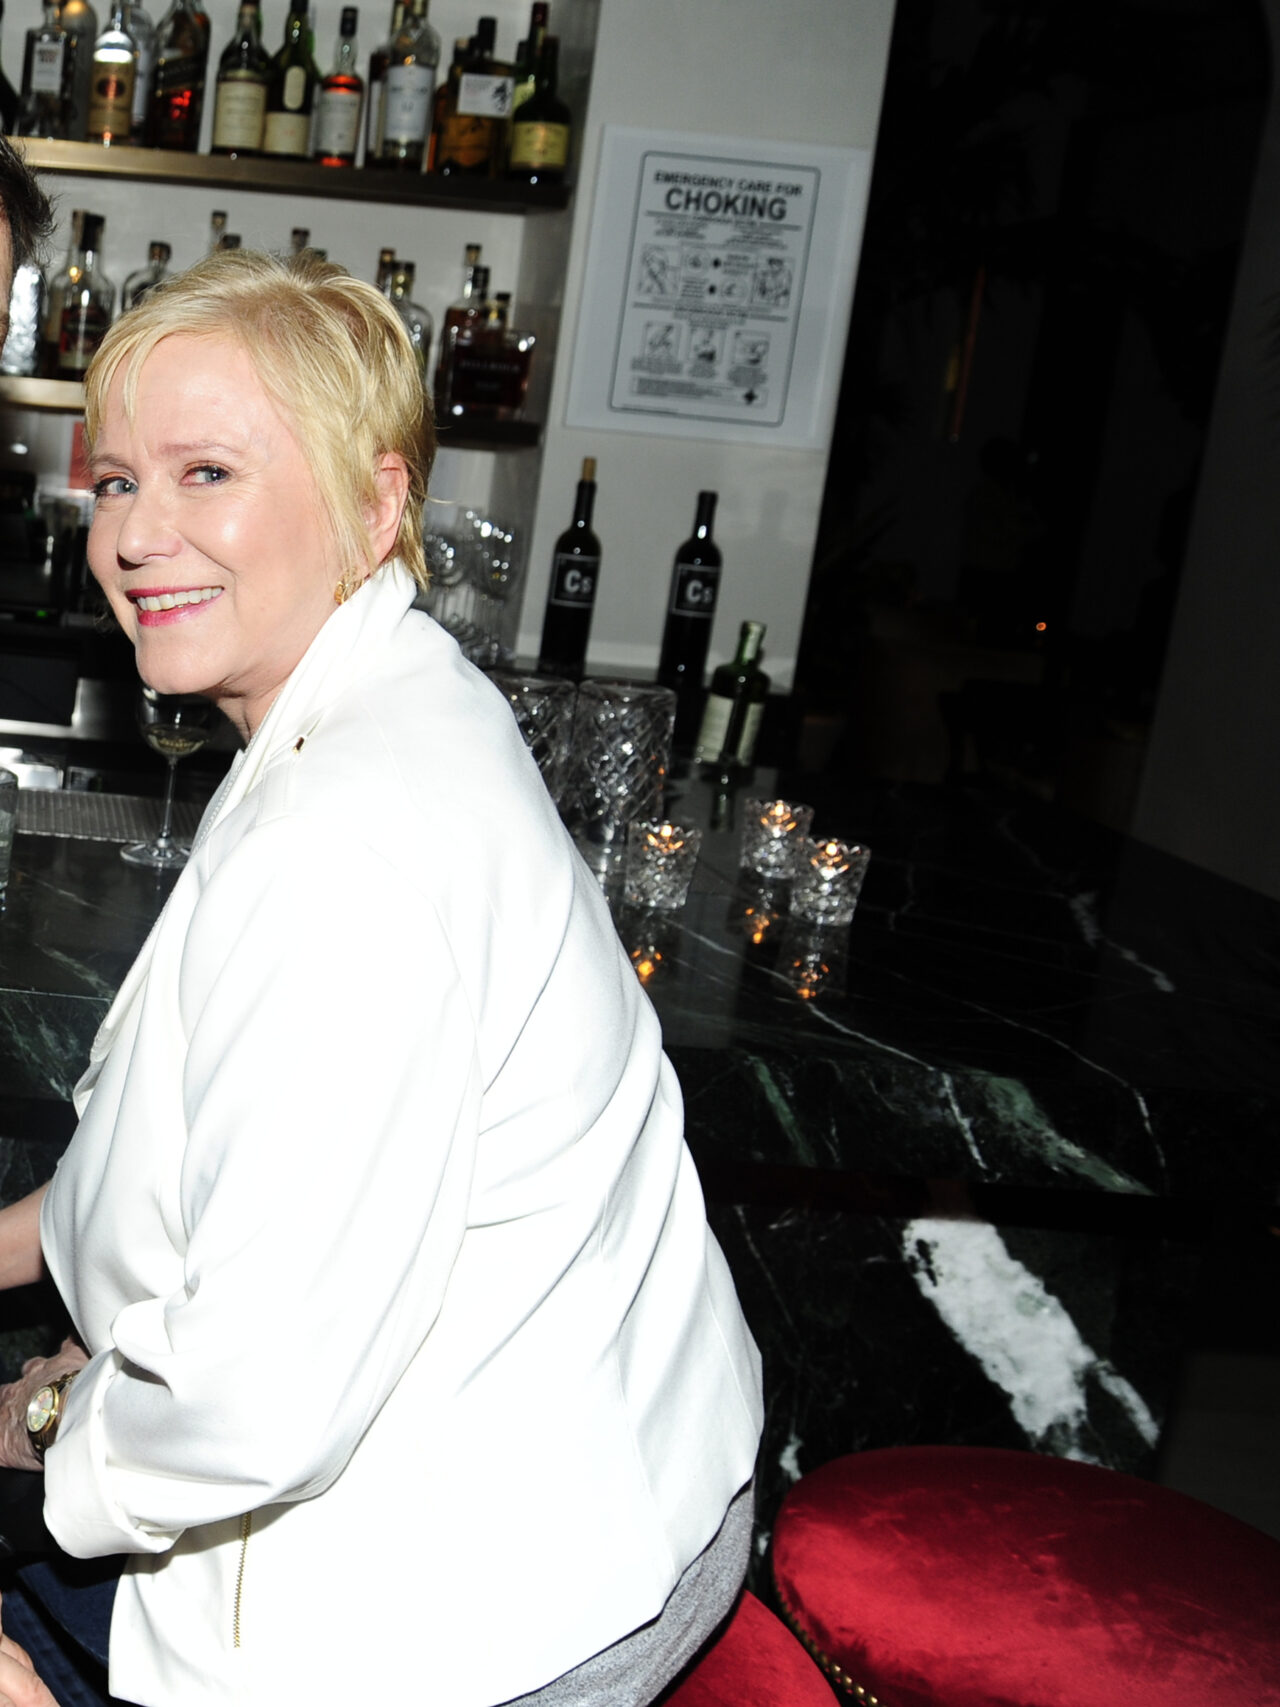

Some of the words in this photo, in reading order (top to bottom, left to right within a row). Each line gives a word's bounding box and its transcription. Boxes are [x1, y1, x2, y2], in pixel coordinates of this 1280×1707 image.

[654, 170, 733, 188] EMERGENCY
[738, 178, 773, 193] CARE
[776, 183, 802, 196] FOR
[665, 187, 787, 221] CHOKING
